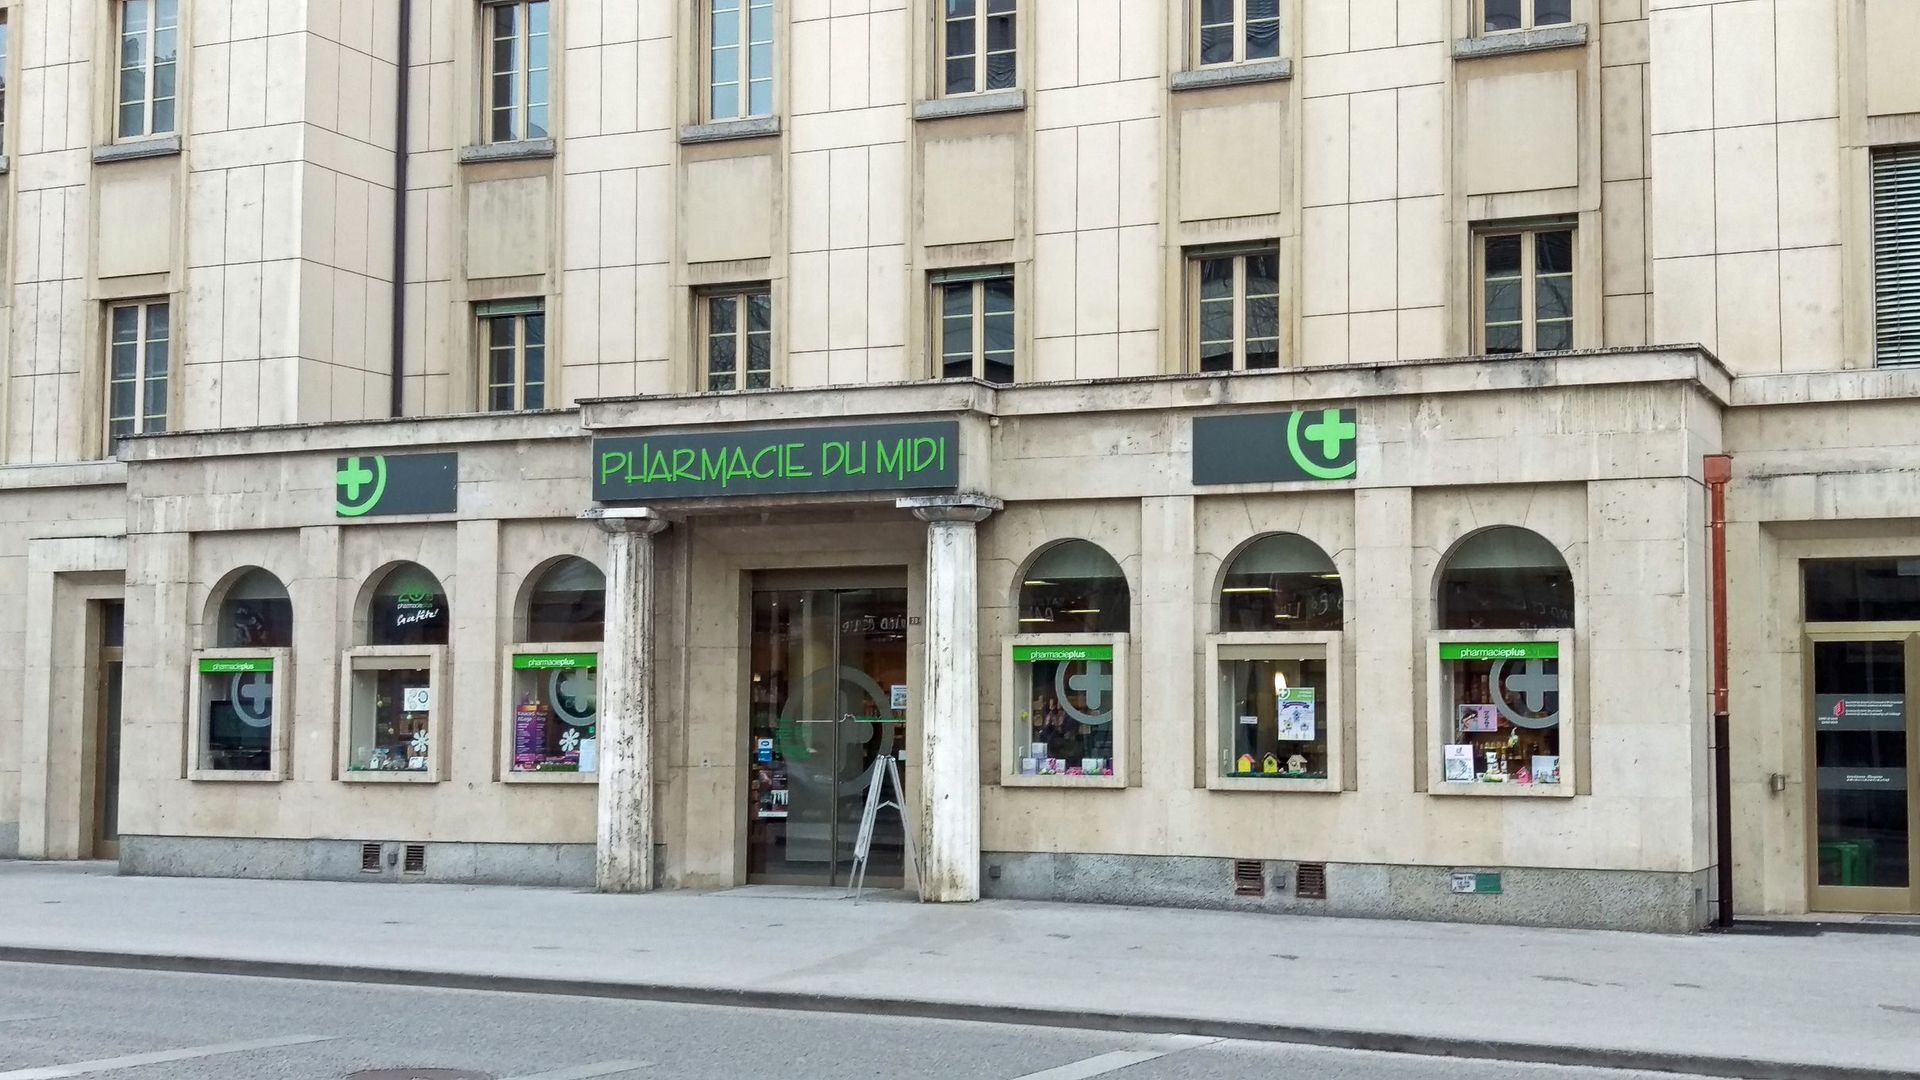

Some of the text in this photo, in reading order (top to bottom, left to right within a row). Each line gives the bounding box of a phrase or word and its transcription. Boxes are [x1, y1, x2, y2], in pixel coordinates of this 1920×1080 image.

[602, 437, 945, 488] PHARMACIE DU MIDI
[1030, 650, 1086, 659] pharmacieplus
[1461, 648, 1526, 658] pharmacieplus
[528, 658, 575, 666] pharmacieplus
